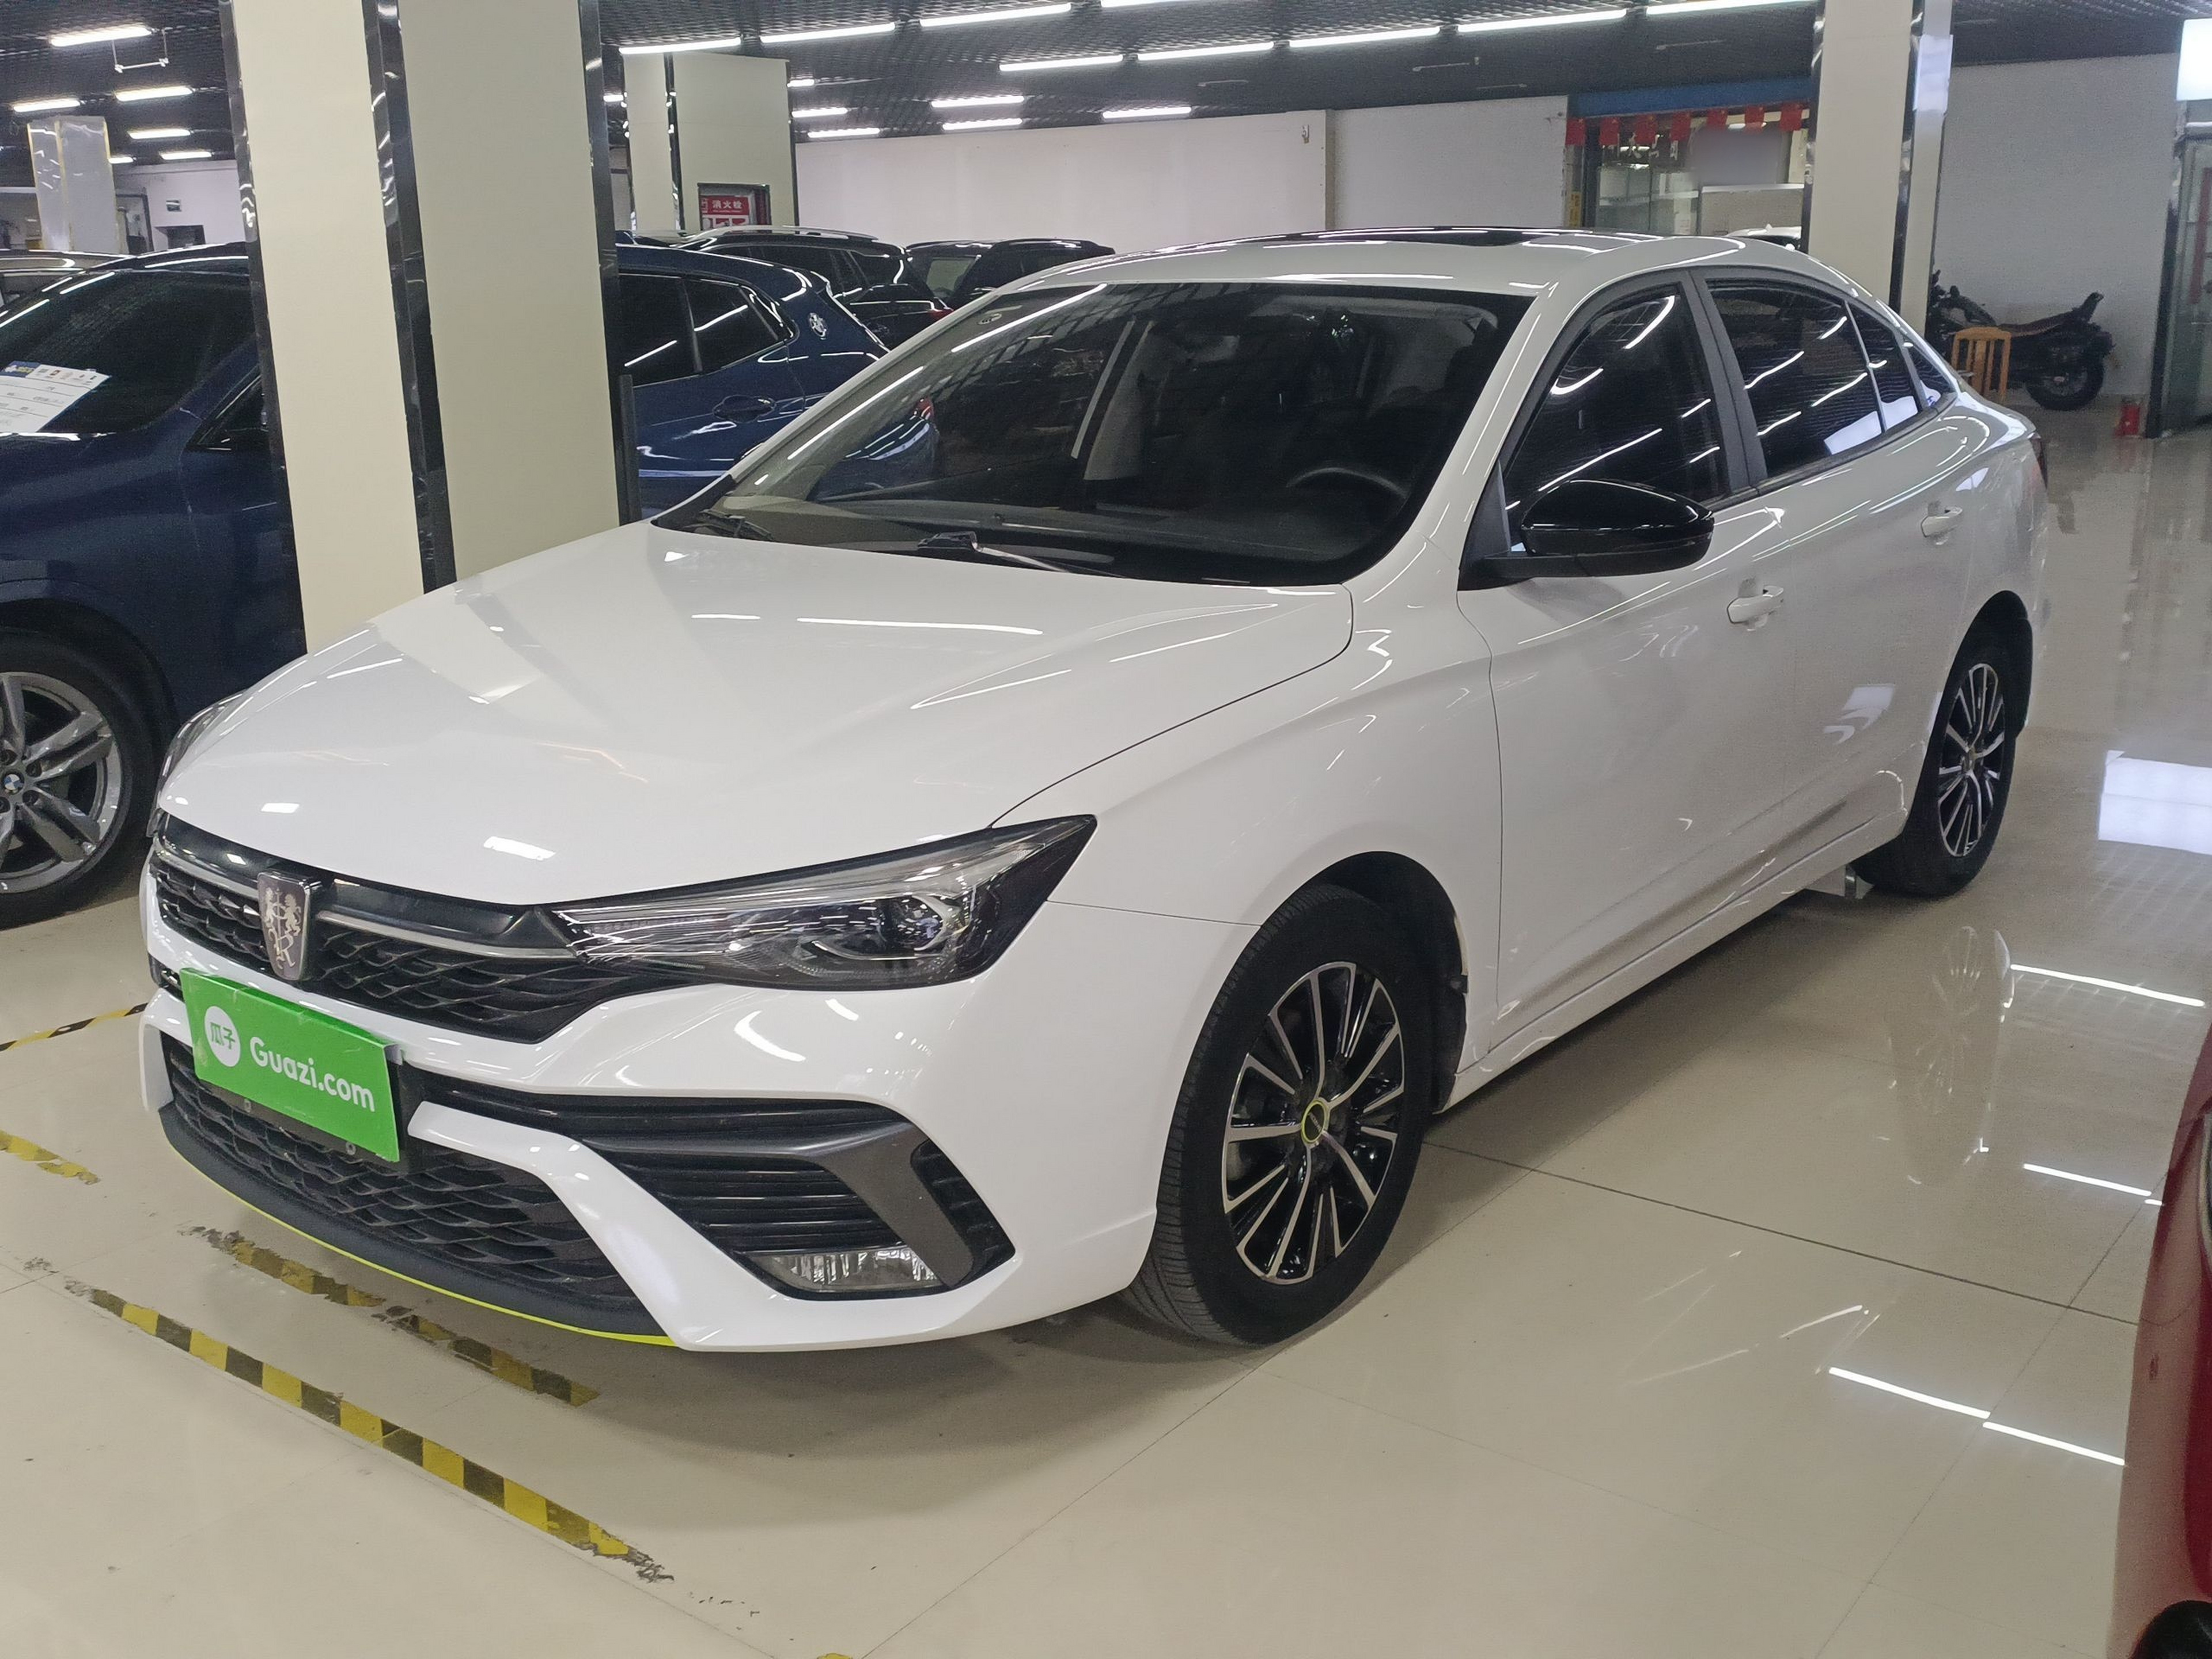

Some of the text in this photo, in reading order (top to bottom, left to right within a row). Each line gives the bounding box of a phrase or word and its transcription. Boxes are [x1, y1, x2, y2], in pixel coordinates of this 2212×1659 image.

[712, 199, 743, 209] 消火栓
[210, 1021, 236, 1050] 瓜子
[249, 1036, 376, 1112] Guazi.com
